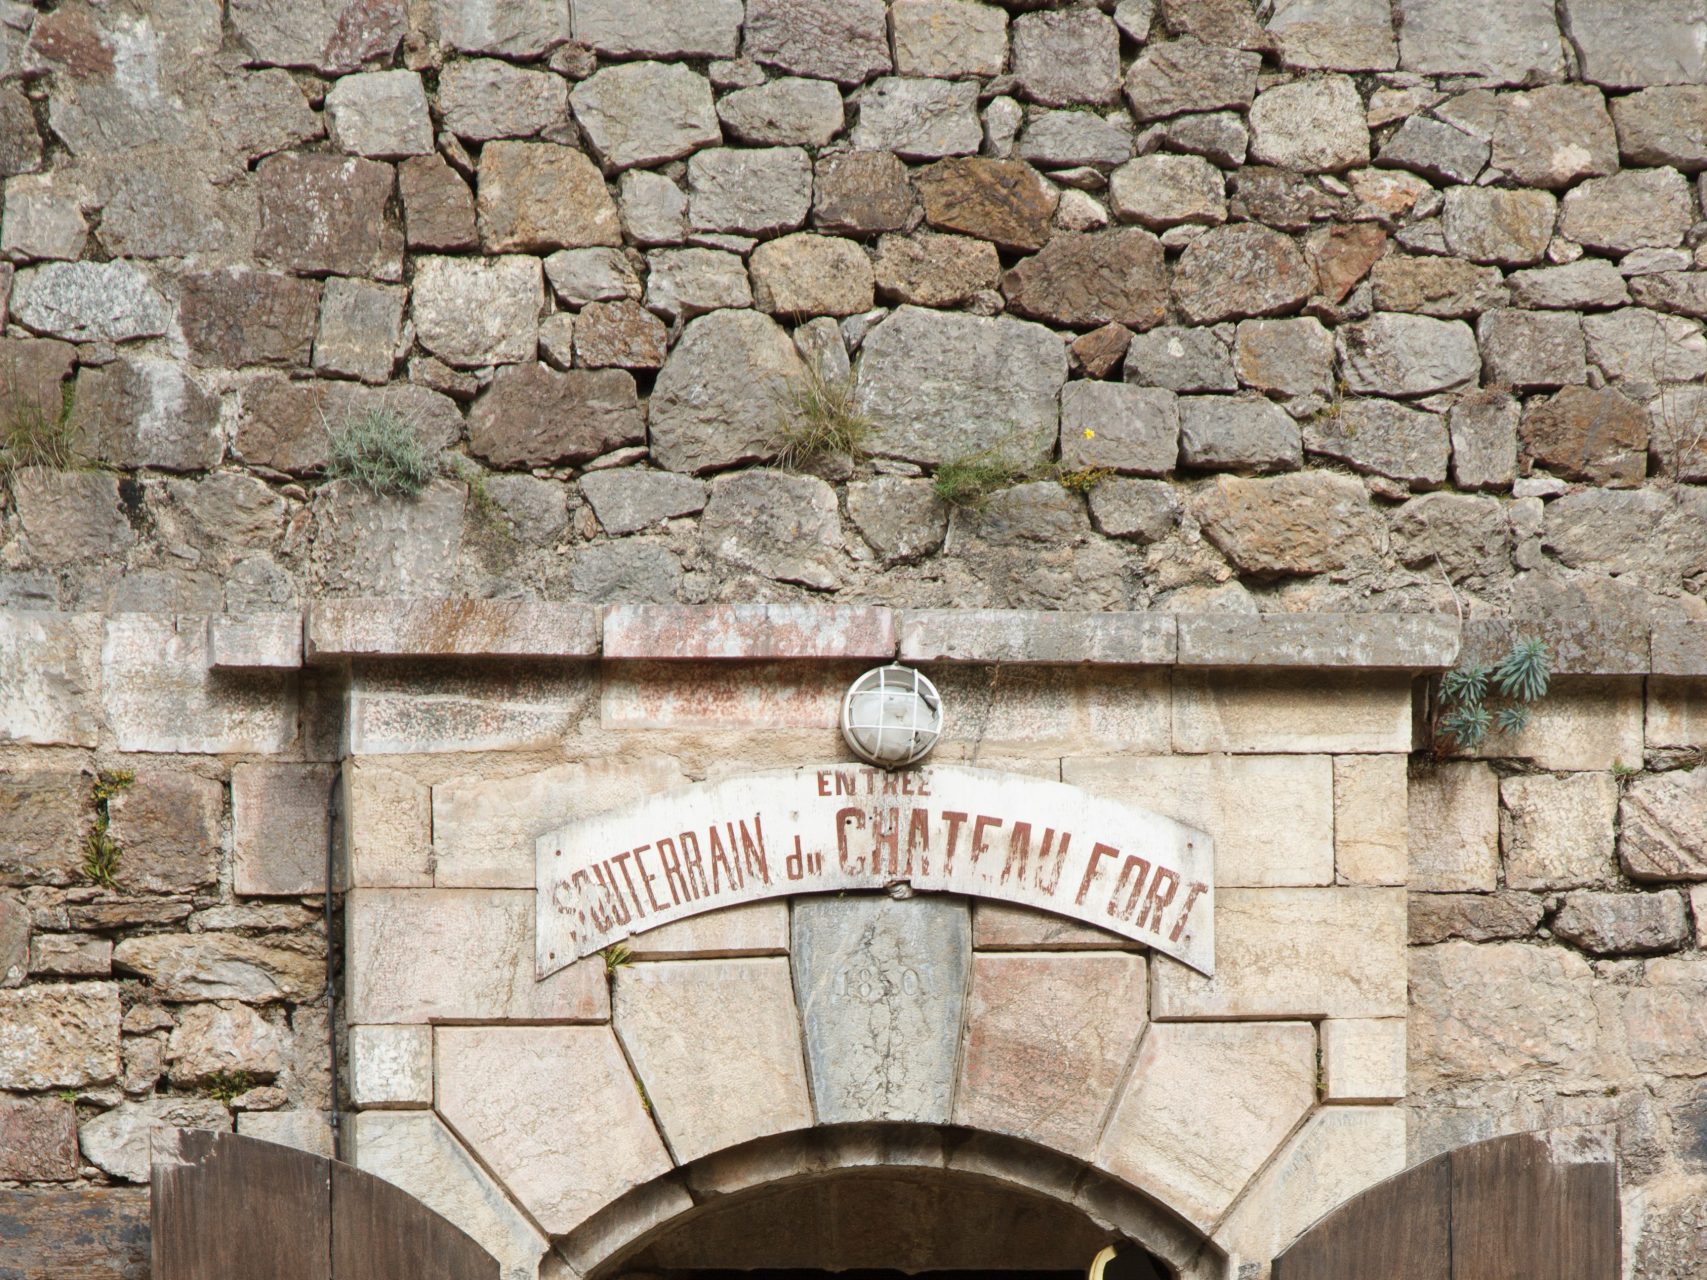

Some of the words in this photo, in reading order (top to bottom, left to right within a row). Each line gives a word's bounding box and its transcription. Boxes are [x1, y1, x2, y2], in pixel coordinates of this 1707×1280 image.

[817, 768, 933, 797] ENTREE
[786, 835, 824, 881] du
[835, 807, 1072, 897] CHATEAU
[1074, 842, 1208, 942] FORT
